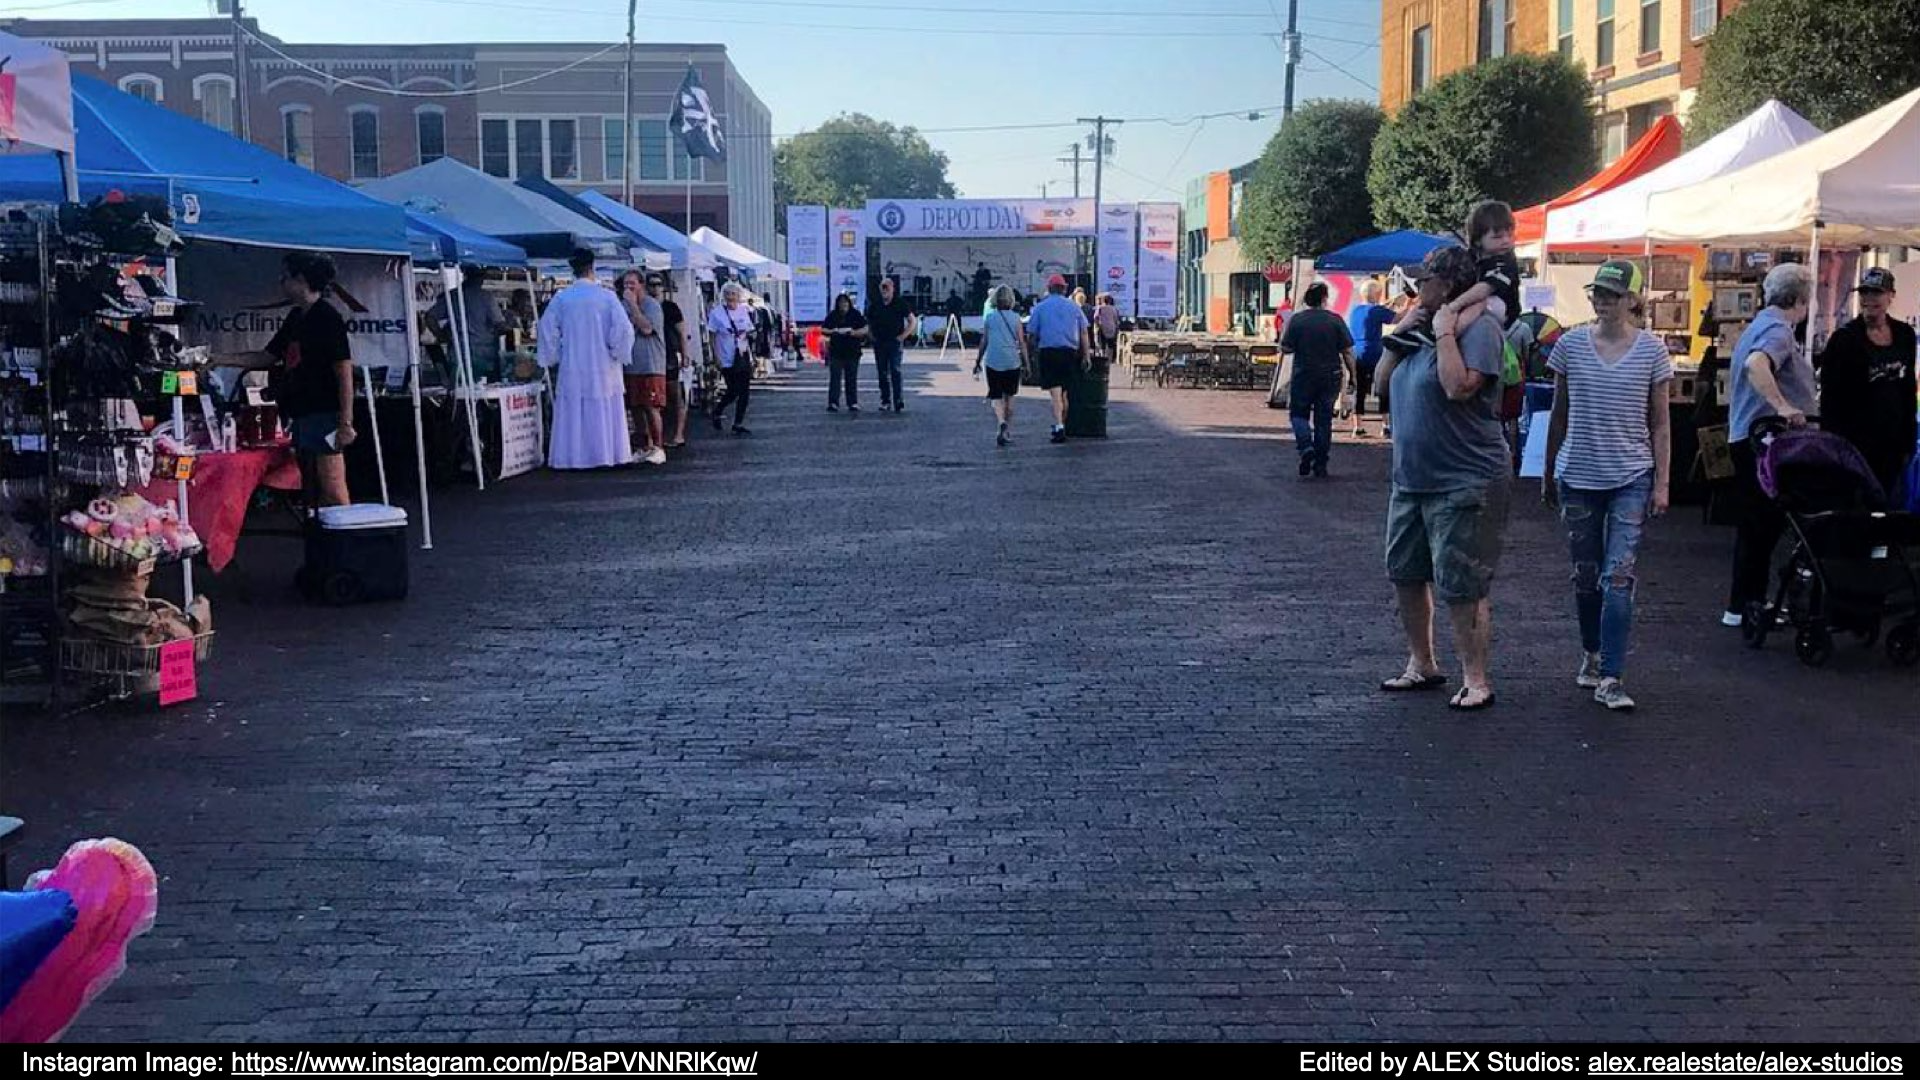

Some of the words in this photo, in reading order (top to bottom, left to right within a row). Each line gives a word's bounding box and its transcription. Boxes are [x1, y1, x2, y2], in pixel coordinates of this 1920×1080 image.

[922, 207, 981, 231] DEPOT
[987, 207, 1024, 230] DAY
[1263, 261, 1291, 275] STOP
[199, 311, 284, 333] McClint
[346, 318, 408, 334] omes
